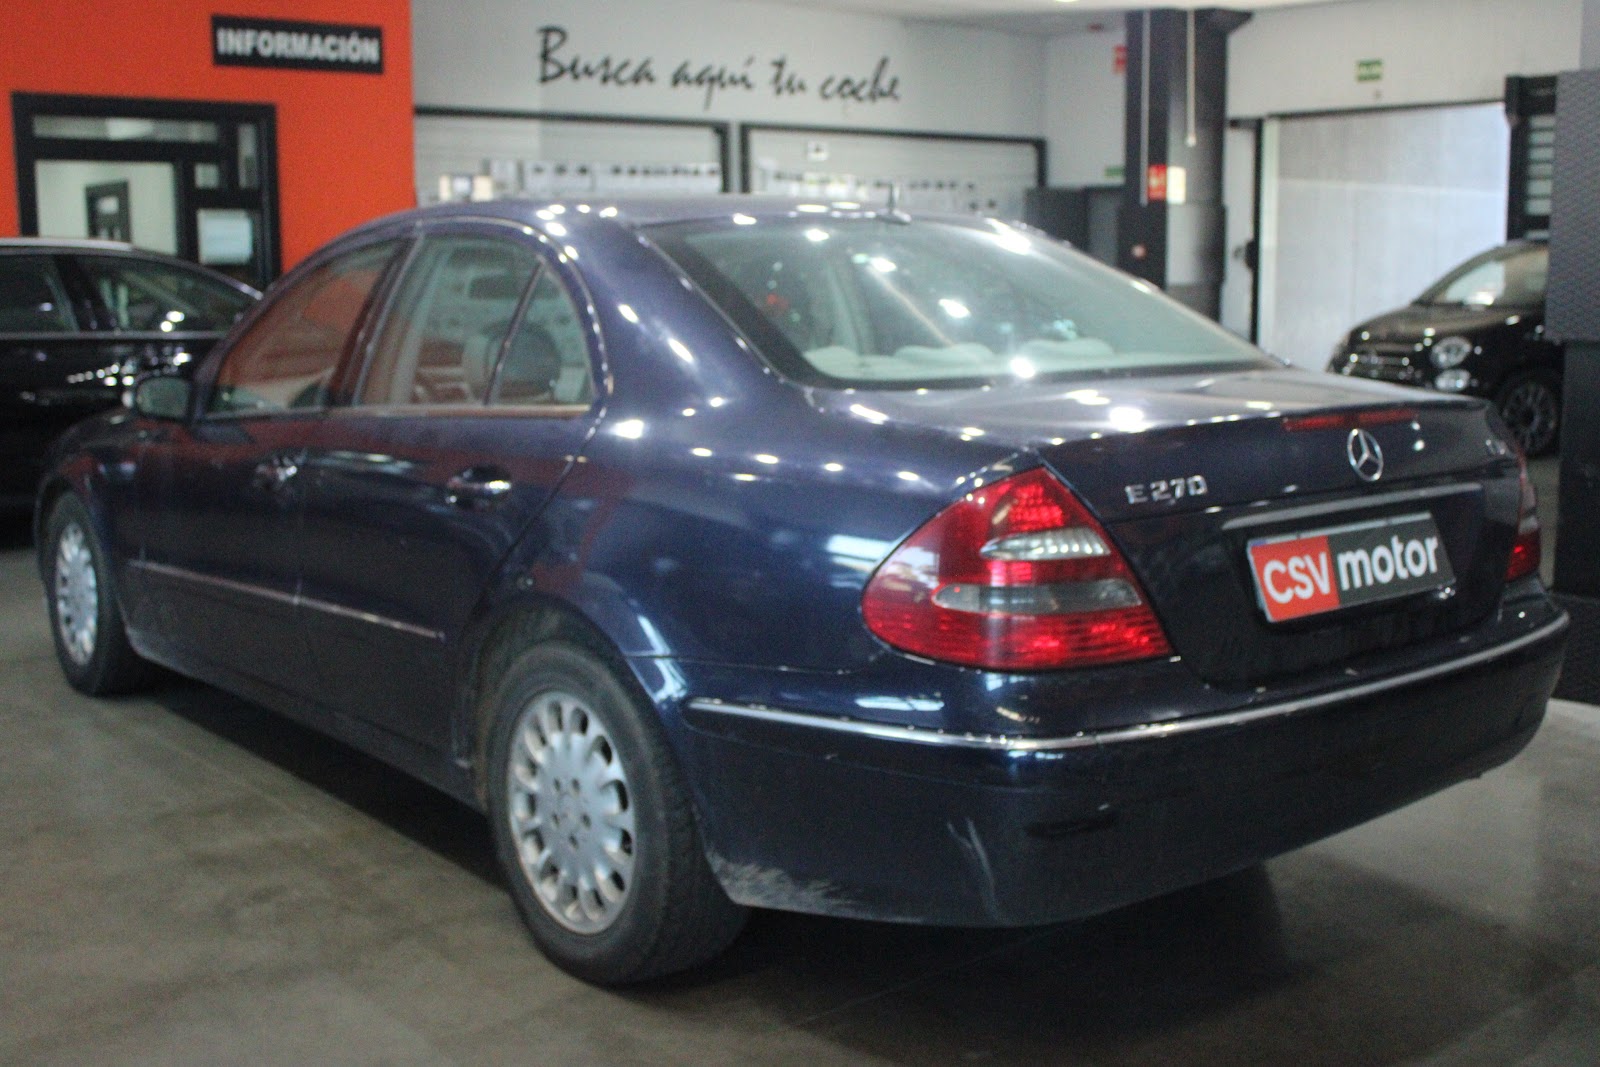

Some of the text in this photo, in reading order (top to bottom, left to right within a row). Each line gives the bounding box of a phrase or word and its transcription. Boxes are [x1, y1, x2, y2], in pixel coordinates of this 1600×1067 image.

[216, 27, 380, 64] INFORMACIÓN
[537, 25, 901, 111] Busca aquí tu coche
[1263, 534, 1440, 604] CSV motor
